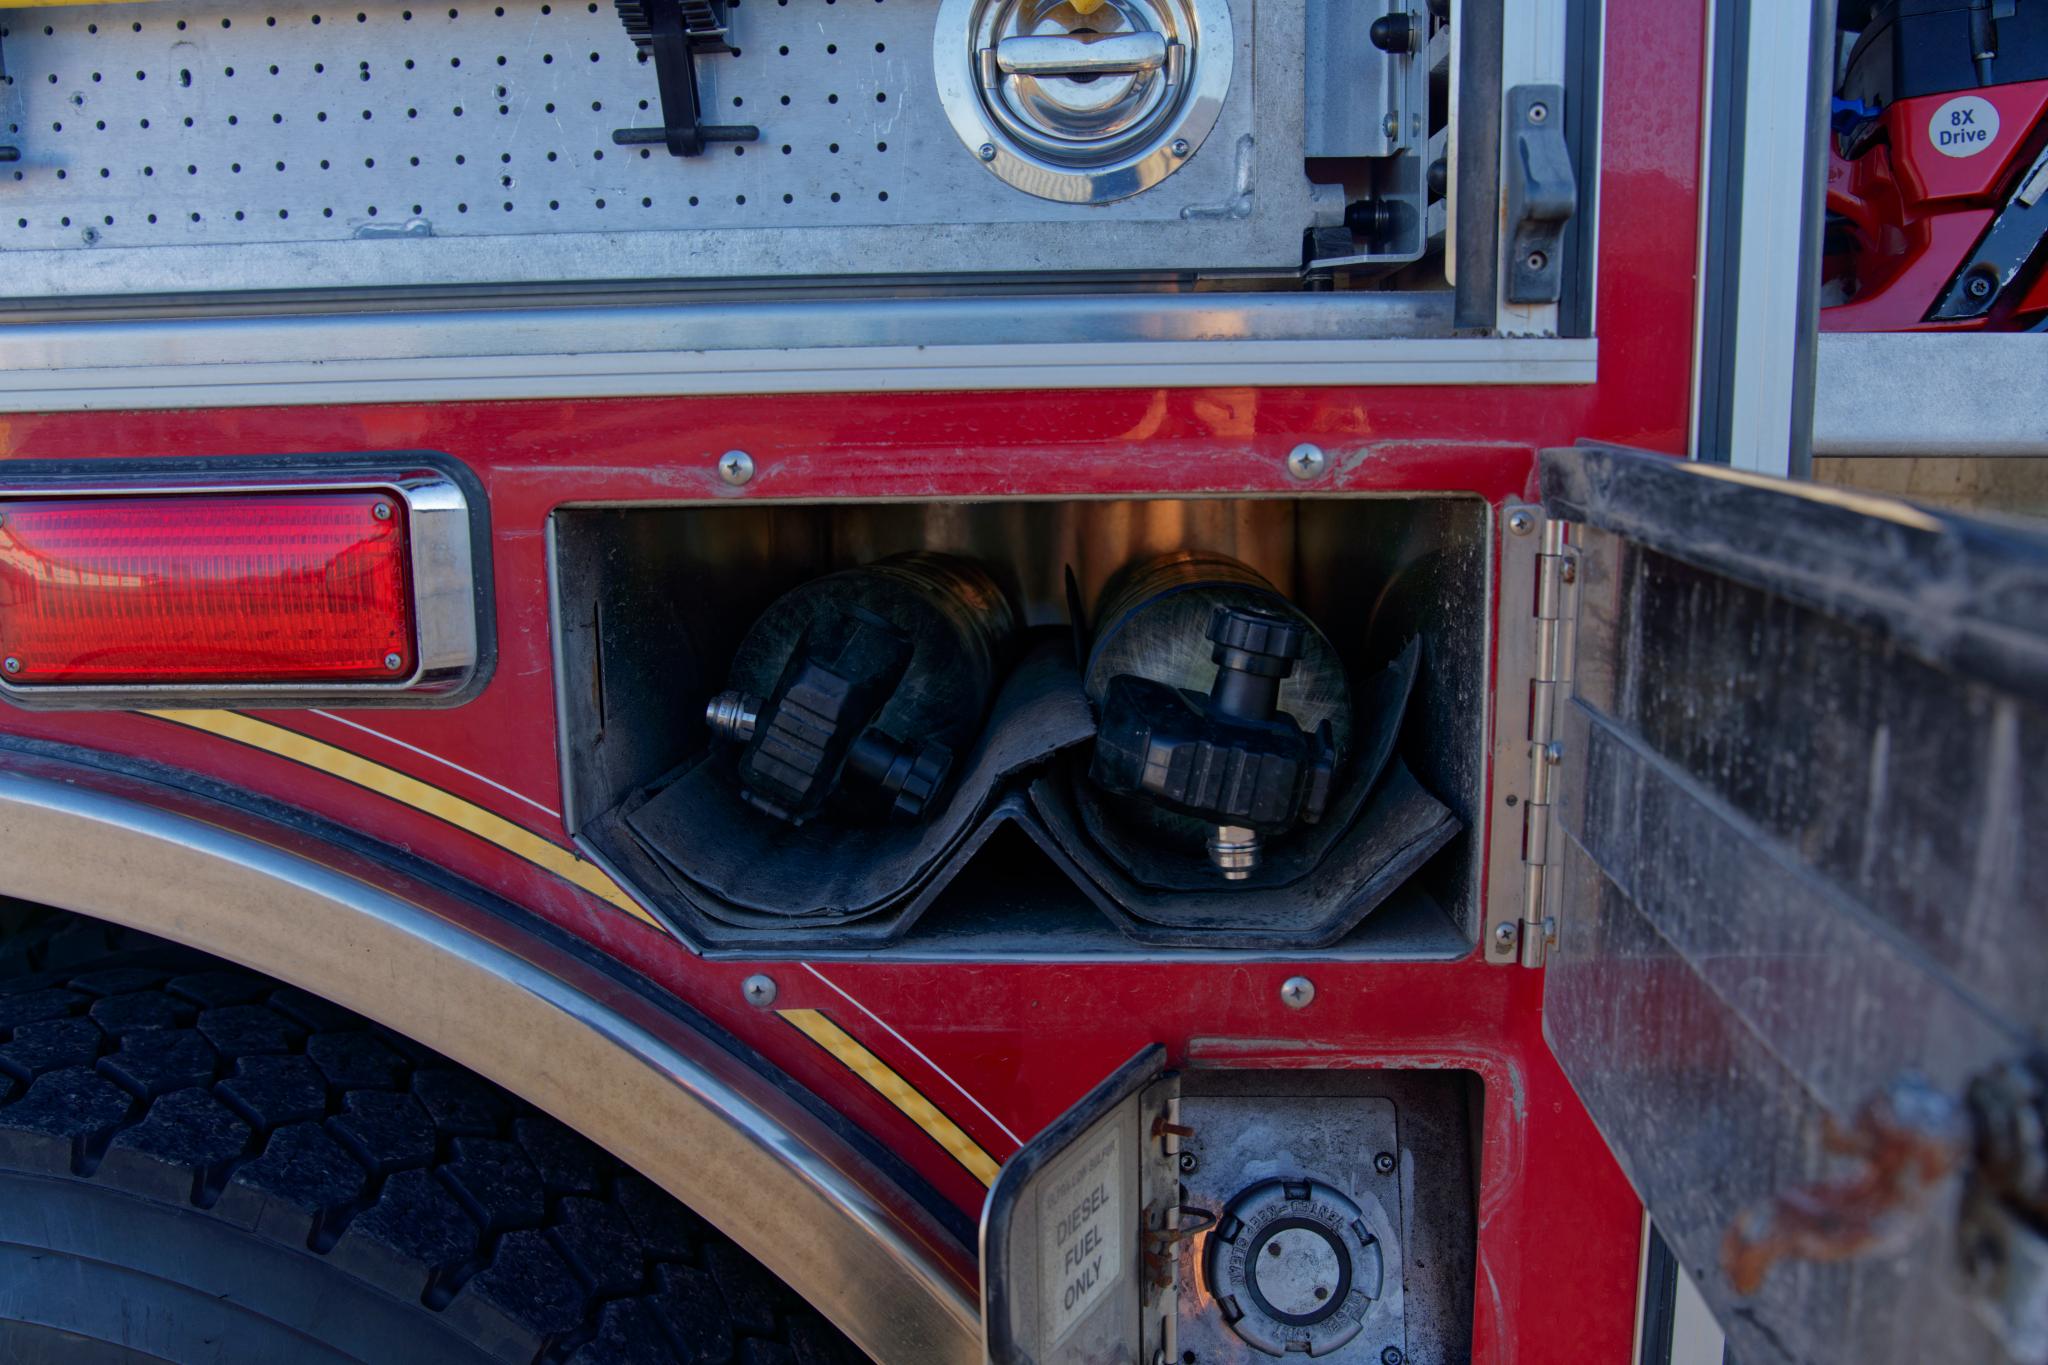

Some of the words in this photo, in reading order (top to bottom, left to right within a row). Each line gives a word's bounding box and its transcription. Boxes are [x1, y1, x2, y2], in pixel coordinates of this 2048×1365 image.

[1940, 128, 1987, 146] Drive
[1951, 109, 1975, 126] 8X
[1056, 1183, 1110, 1247] DIESEL
[1065, 1224, 1103, 1276] FUEL
[1229, 1237, 1250, 1286] CLEAN
[1064, 1256, 1103, 1311] ONLY
